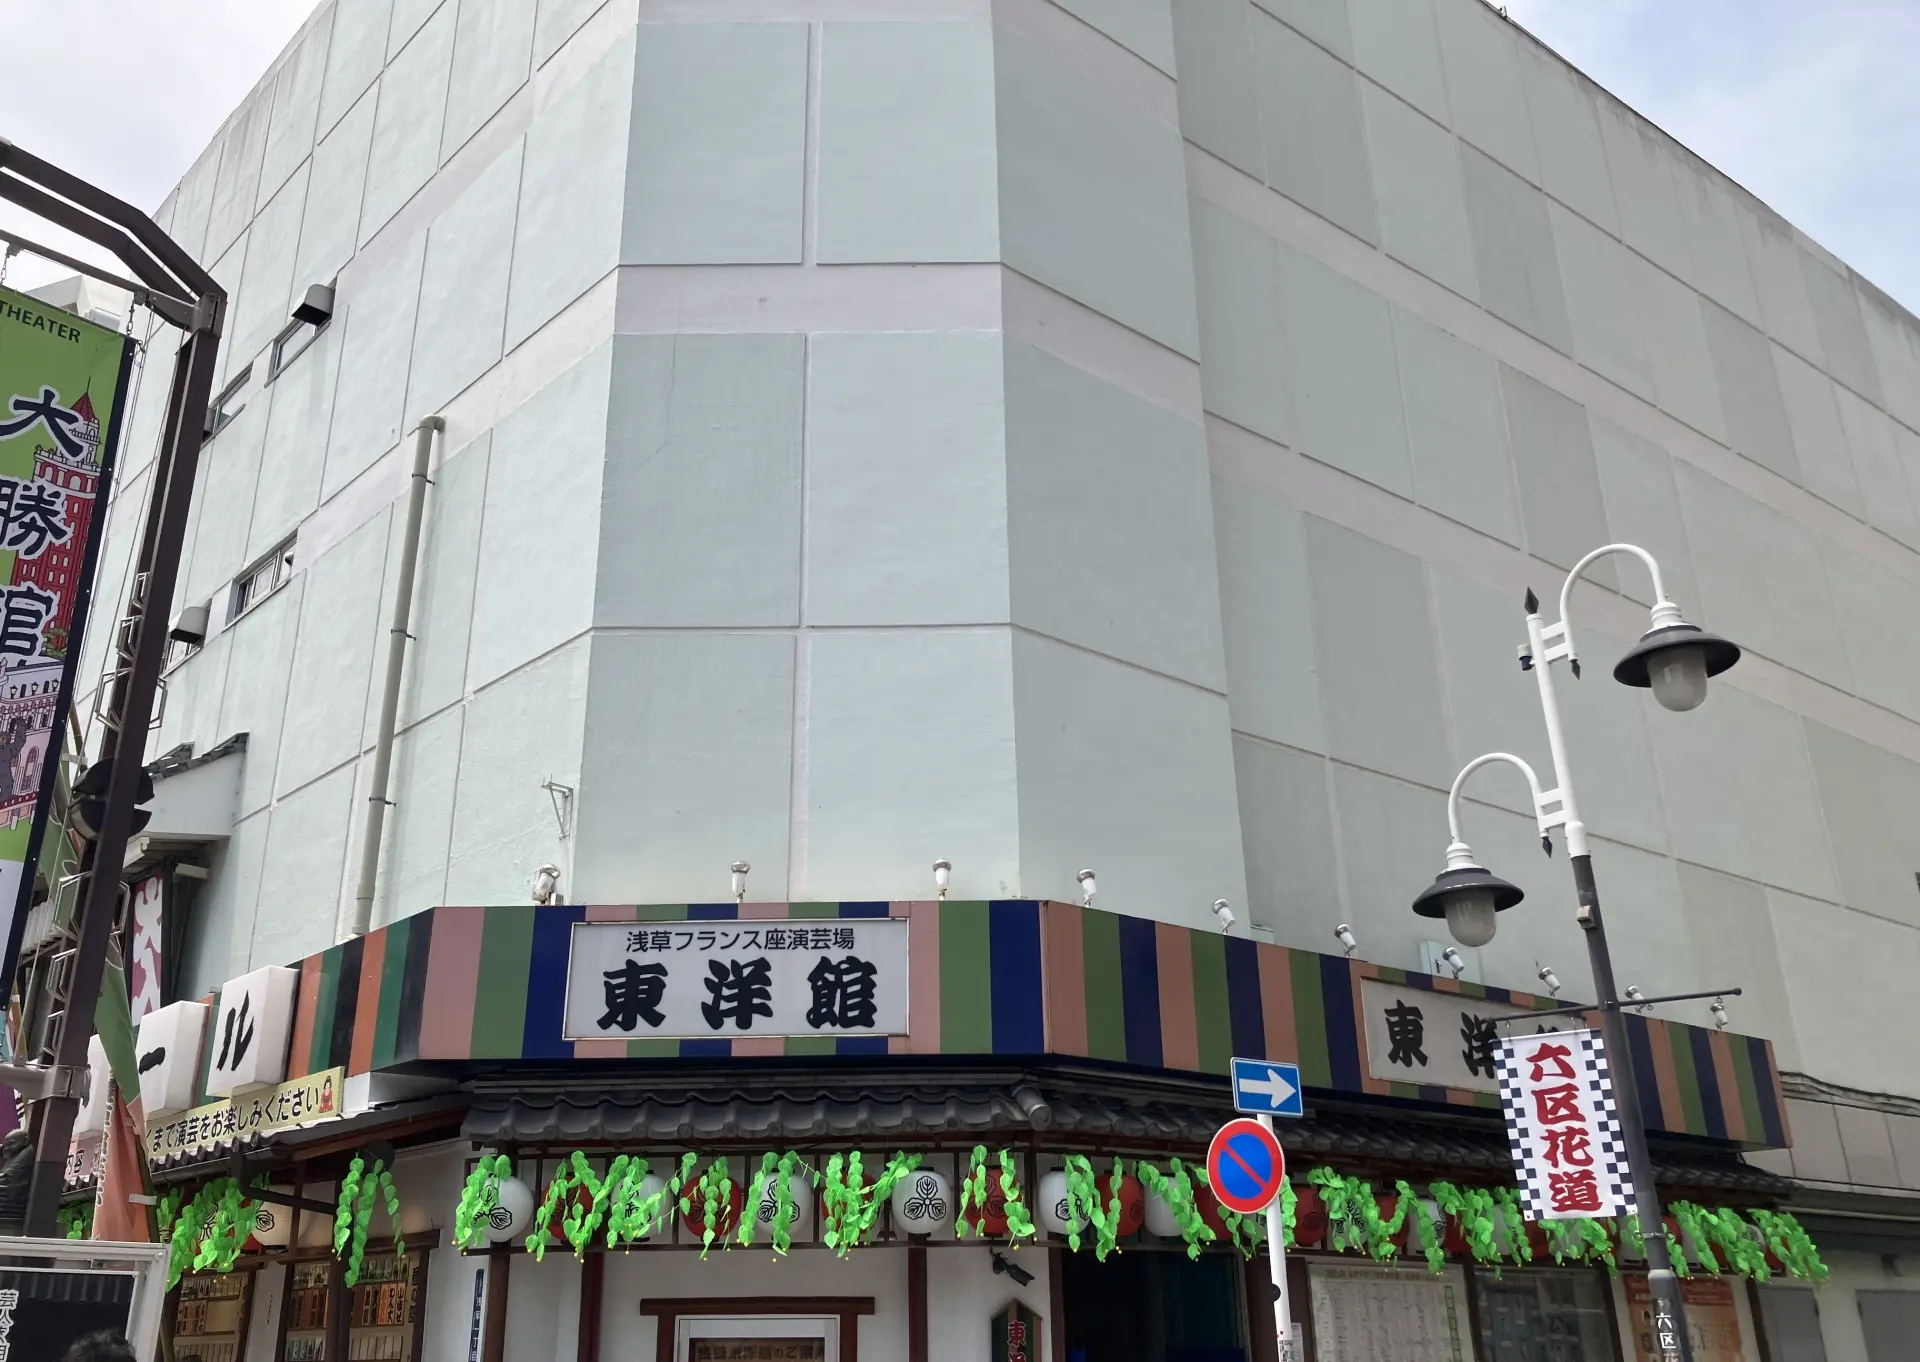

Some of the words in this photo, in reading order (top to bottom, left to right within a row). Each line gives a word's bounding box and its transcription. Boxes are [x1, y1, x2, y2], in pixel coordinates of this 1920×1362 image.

[0, 300, 81, 344] THEATER
[626, 927, 855, 952] 浅草フランス座演芸場
[596, 956, 878, 1031] 東洋館
[1526, 1043, 1603, 1212] 六区花道
